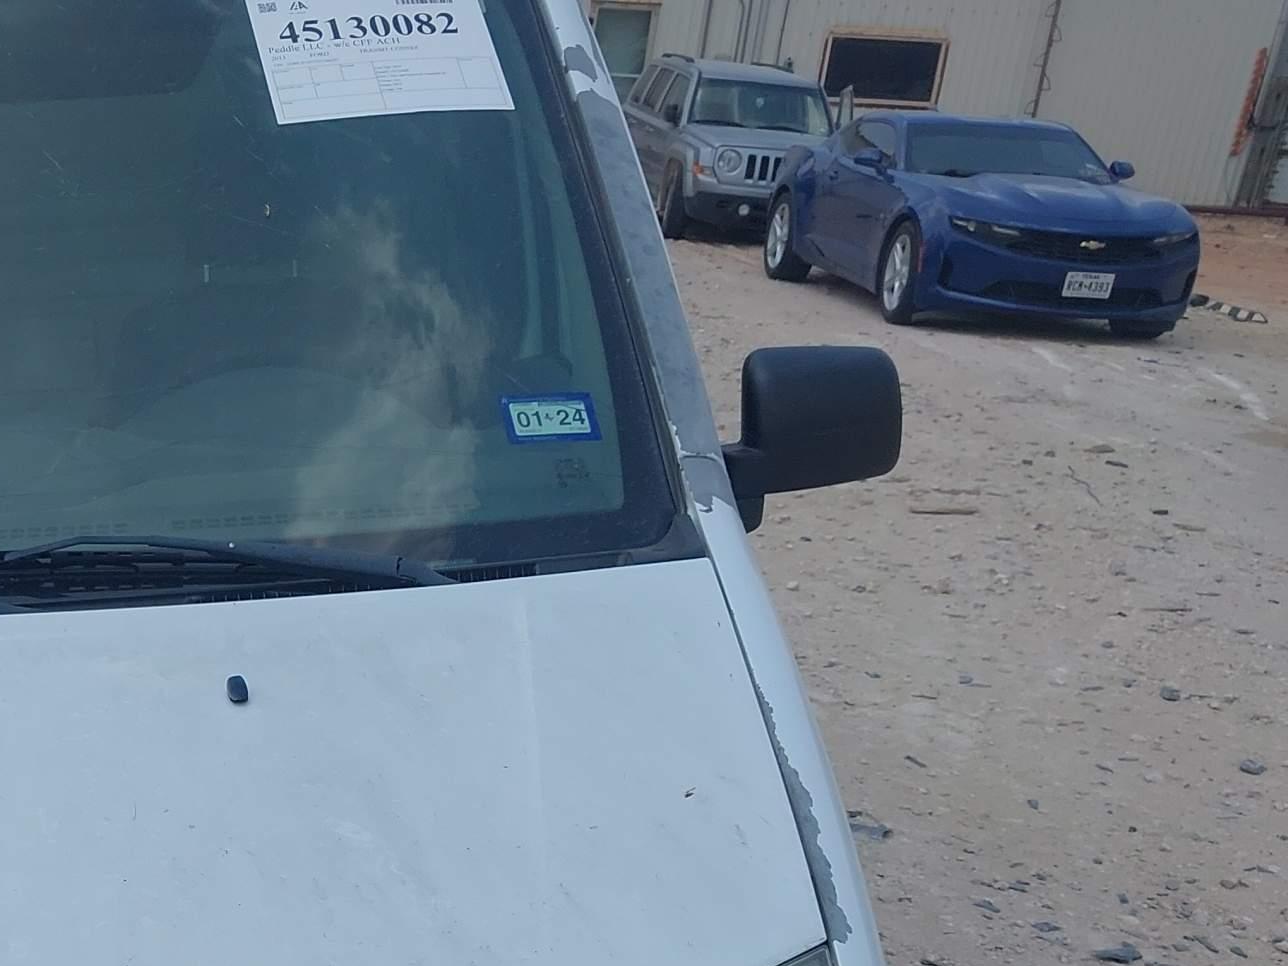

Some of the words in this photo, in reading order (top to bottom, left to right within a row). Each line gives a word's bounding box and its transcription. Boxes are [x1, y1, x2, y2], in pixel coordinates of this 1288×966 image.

[279, 12, 458, 44] 45130082
[268, 44, 300, 54] Peddle
[516, 411, 543, 428] 01
[556, 409, 586, 426] 24
